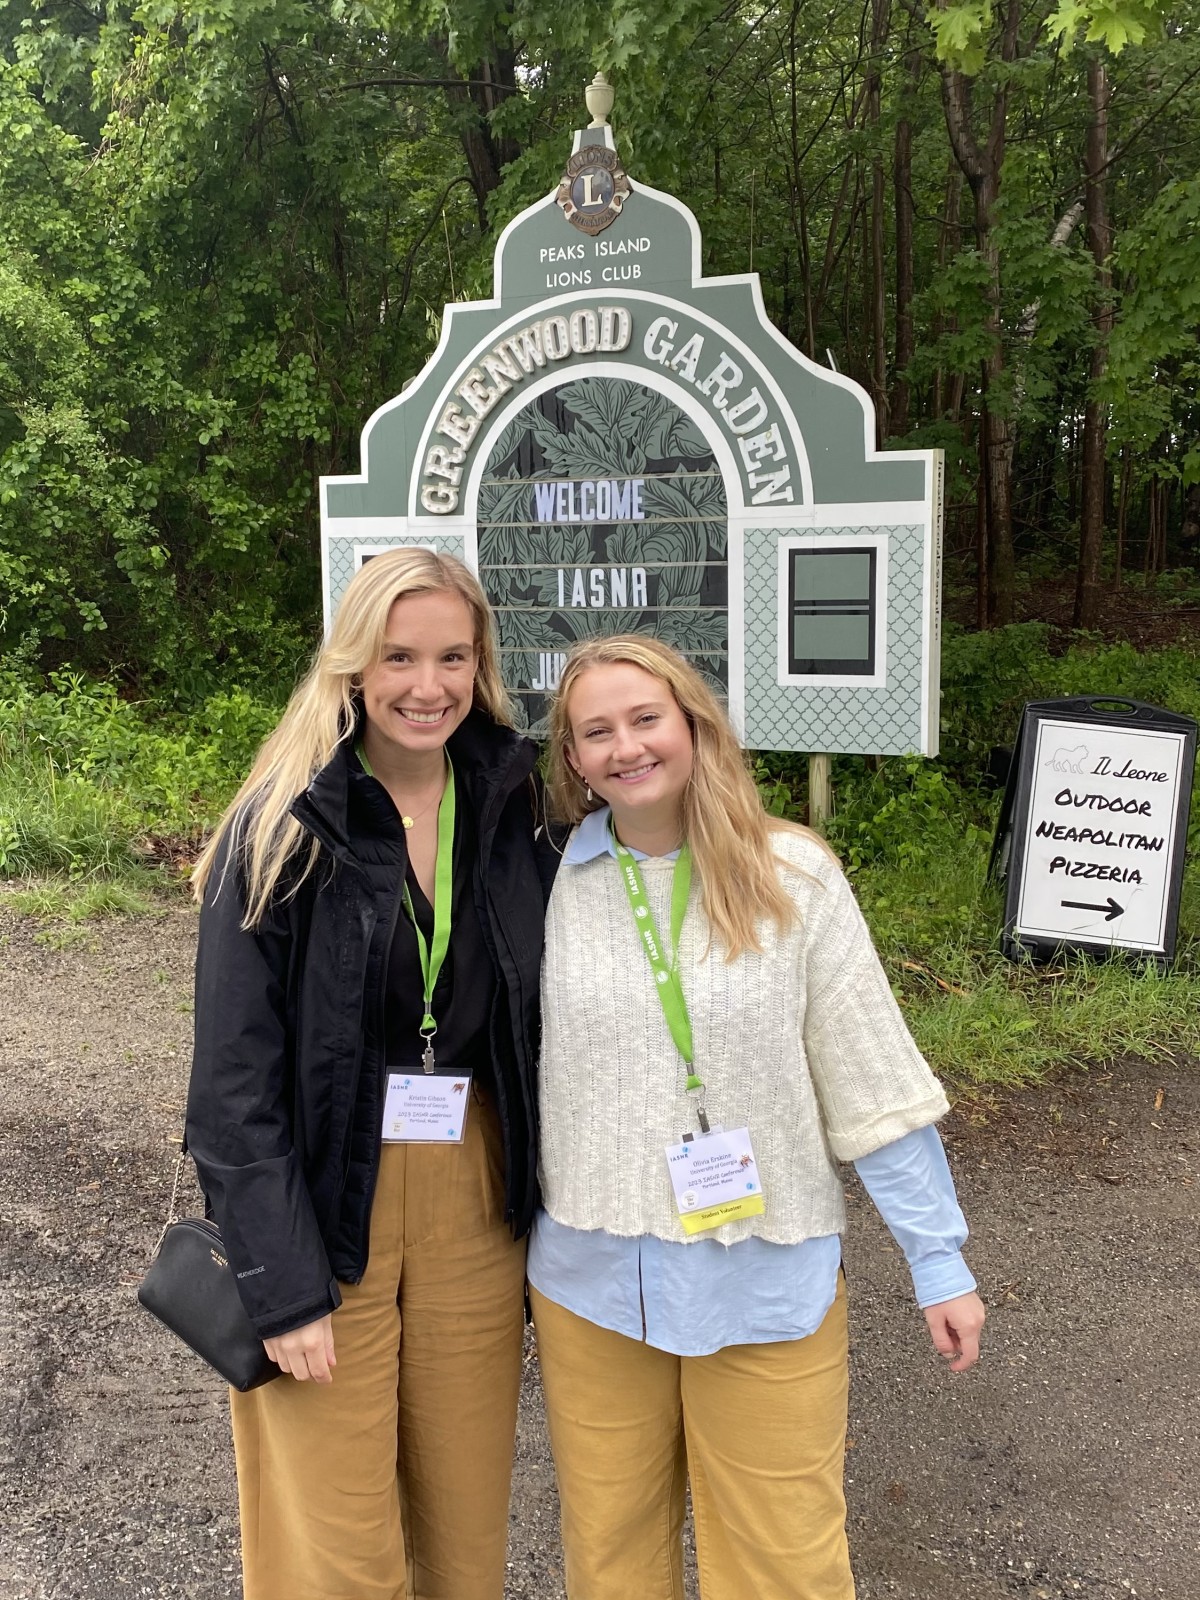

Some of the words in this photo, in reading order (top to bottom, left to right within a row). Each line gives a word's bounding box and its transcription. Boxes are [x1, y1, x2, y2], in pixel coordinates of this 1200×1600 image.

[581, 174, 603, 207] L
[540, 244, 585, 263] PEAKS
[595, 237, 651, 257] ISLAND
[546, 269, 592, 288] LIONS
[602, 264, 641, 282] CLUB
[420, 306, 633, 514] GREENWOOD
[643, 316, 794, 505] GARDEN
[534, 479, 645, 522] WELCOME
[557, 567, 648, 607] IASNR
[1113, 759, 1169, 783] Leone
[1054, 788, 1152, 817] OUTDOOR
[1035, 820, 1164, 851] NEAPOLITAN
[626, 865, 640, 896] IASNR
[1049, 856, 1143, 884] PIZZERIA
[644, 930, 660, 961] IASNR
[689, 1165, 714, 1176] University
[720, 1159, 738, 1168] Georgia
[692, 1159, 710, 1168] Olivia
[710, 1153, 732, 1163] Erskine
